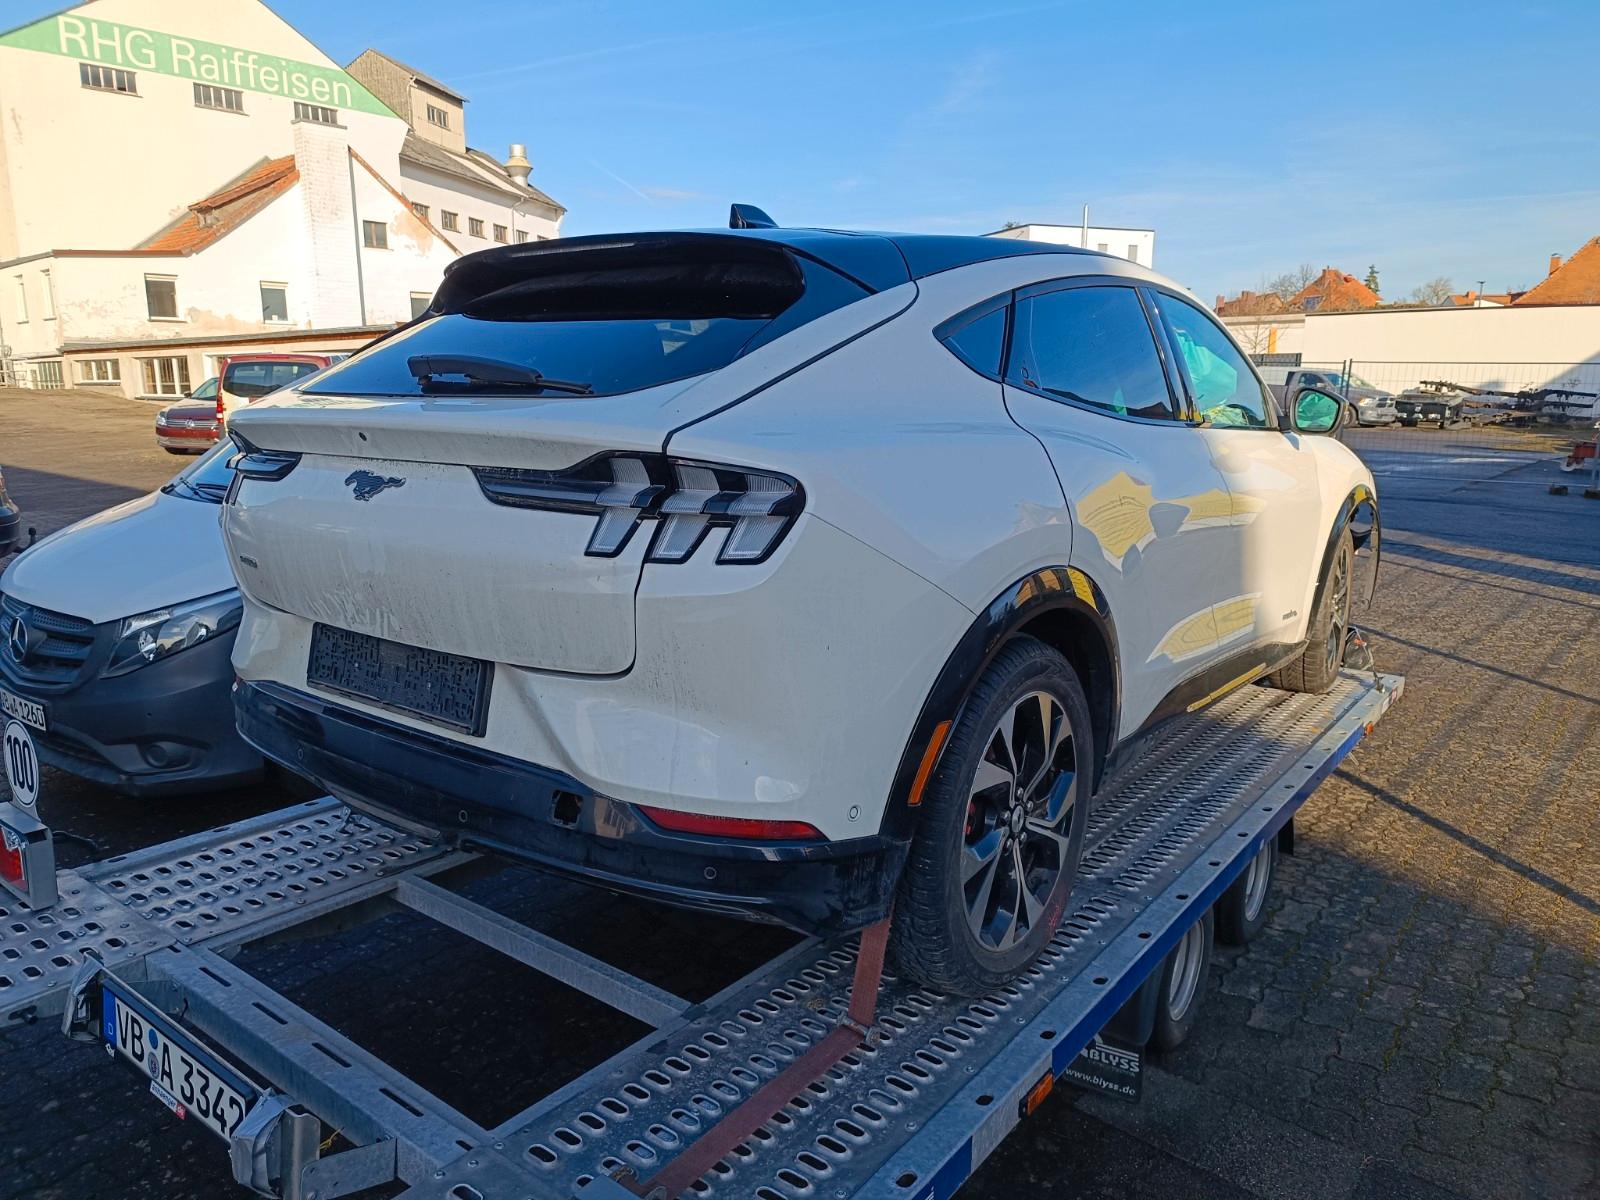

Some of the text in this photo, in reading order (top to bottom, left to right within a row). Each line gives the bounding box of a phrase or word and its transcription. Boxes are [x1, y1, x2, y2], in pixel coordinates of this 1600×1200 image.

[57, 15, 352, 107] RHG Raiffeisen
[7, 735, 34, 793] 100
[117, 1004, 144, 1063] VB
[1089, 1049, 1140, 1072] BLYSS
[1065, 1068, 1136, 1096] www.blyss.de
